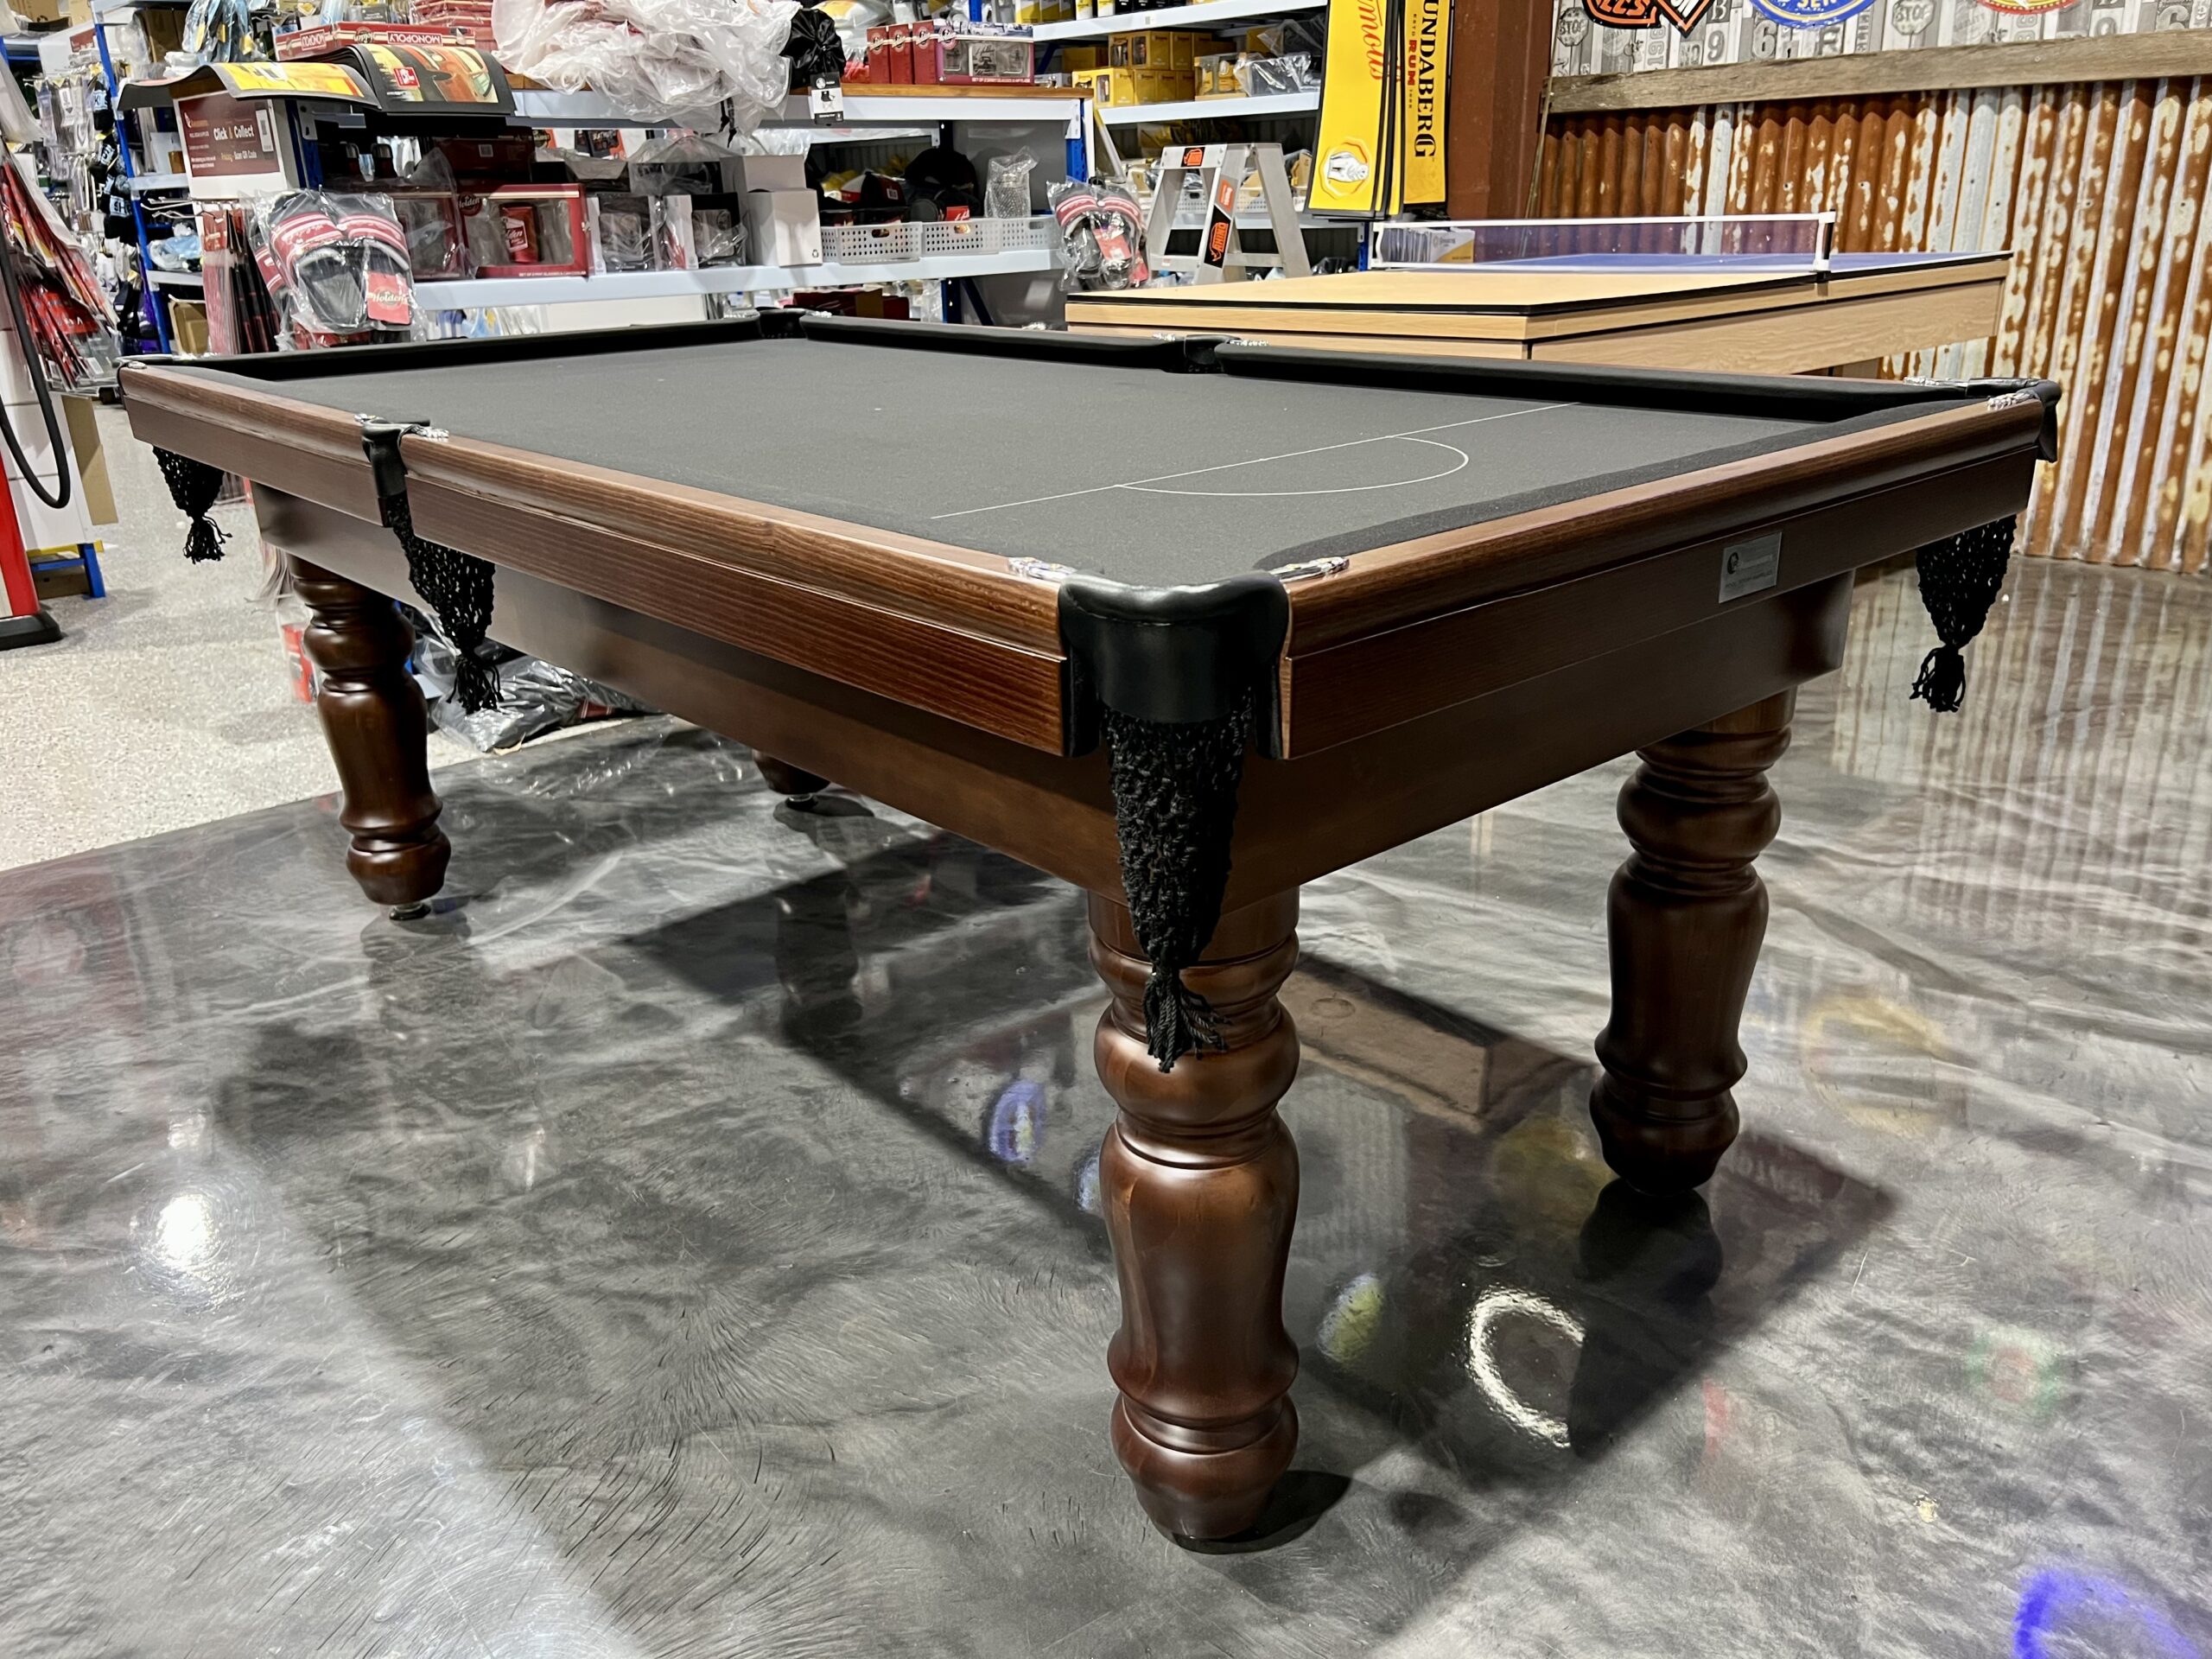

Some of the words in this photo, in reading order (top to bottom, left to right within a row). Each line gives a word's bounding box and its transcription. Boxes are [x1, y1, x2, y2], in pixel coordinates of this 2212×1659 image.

[389, 33, 441, 43] MONOPOLY
[1408, 40, 1417, 86] RUM
[213, 127, 228, 141] Click
[233, 124, 255, 138] Collect
